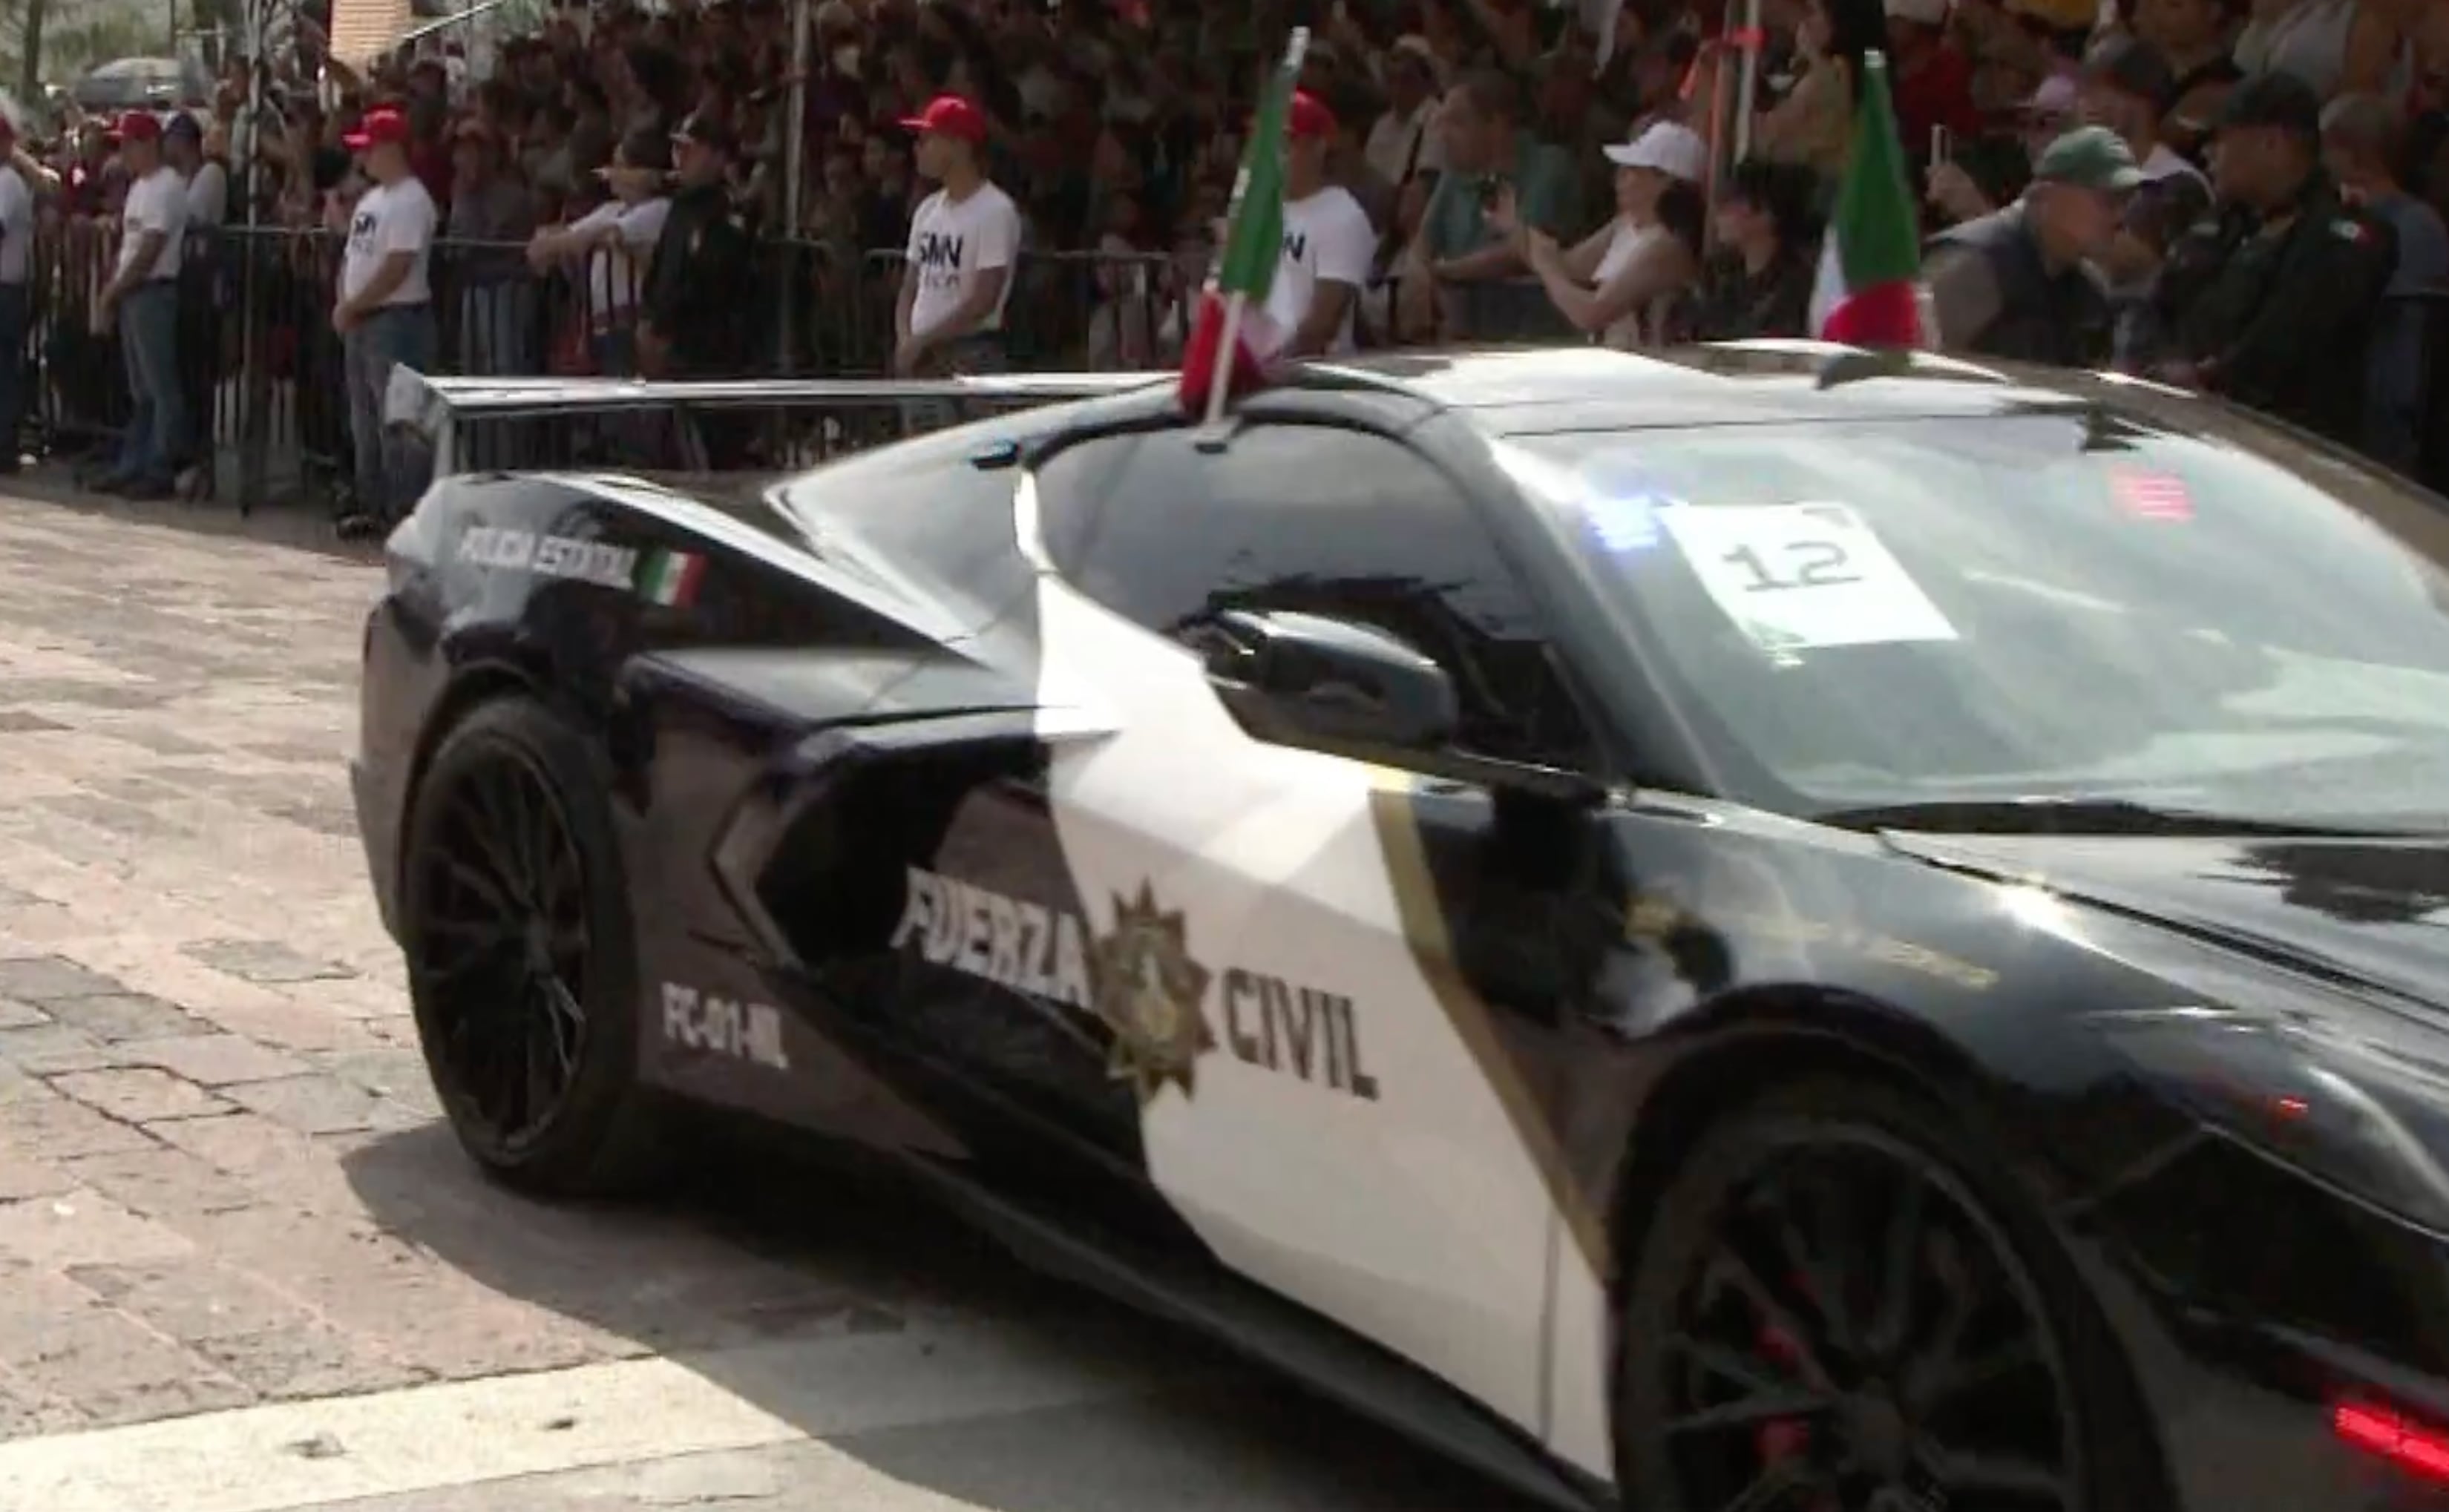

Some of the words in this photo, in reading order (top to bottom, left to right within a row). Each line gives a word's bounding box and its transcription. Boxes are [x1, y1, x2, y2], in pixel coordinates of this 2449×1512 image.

[1721, 542, 1864, 591] 12
[890, 866, 1094, 1011] FUERZA
[1219, 966, 1381, 1100] CIVIL
